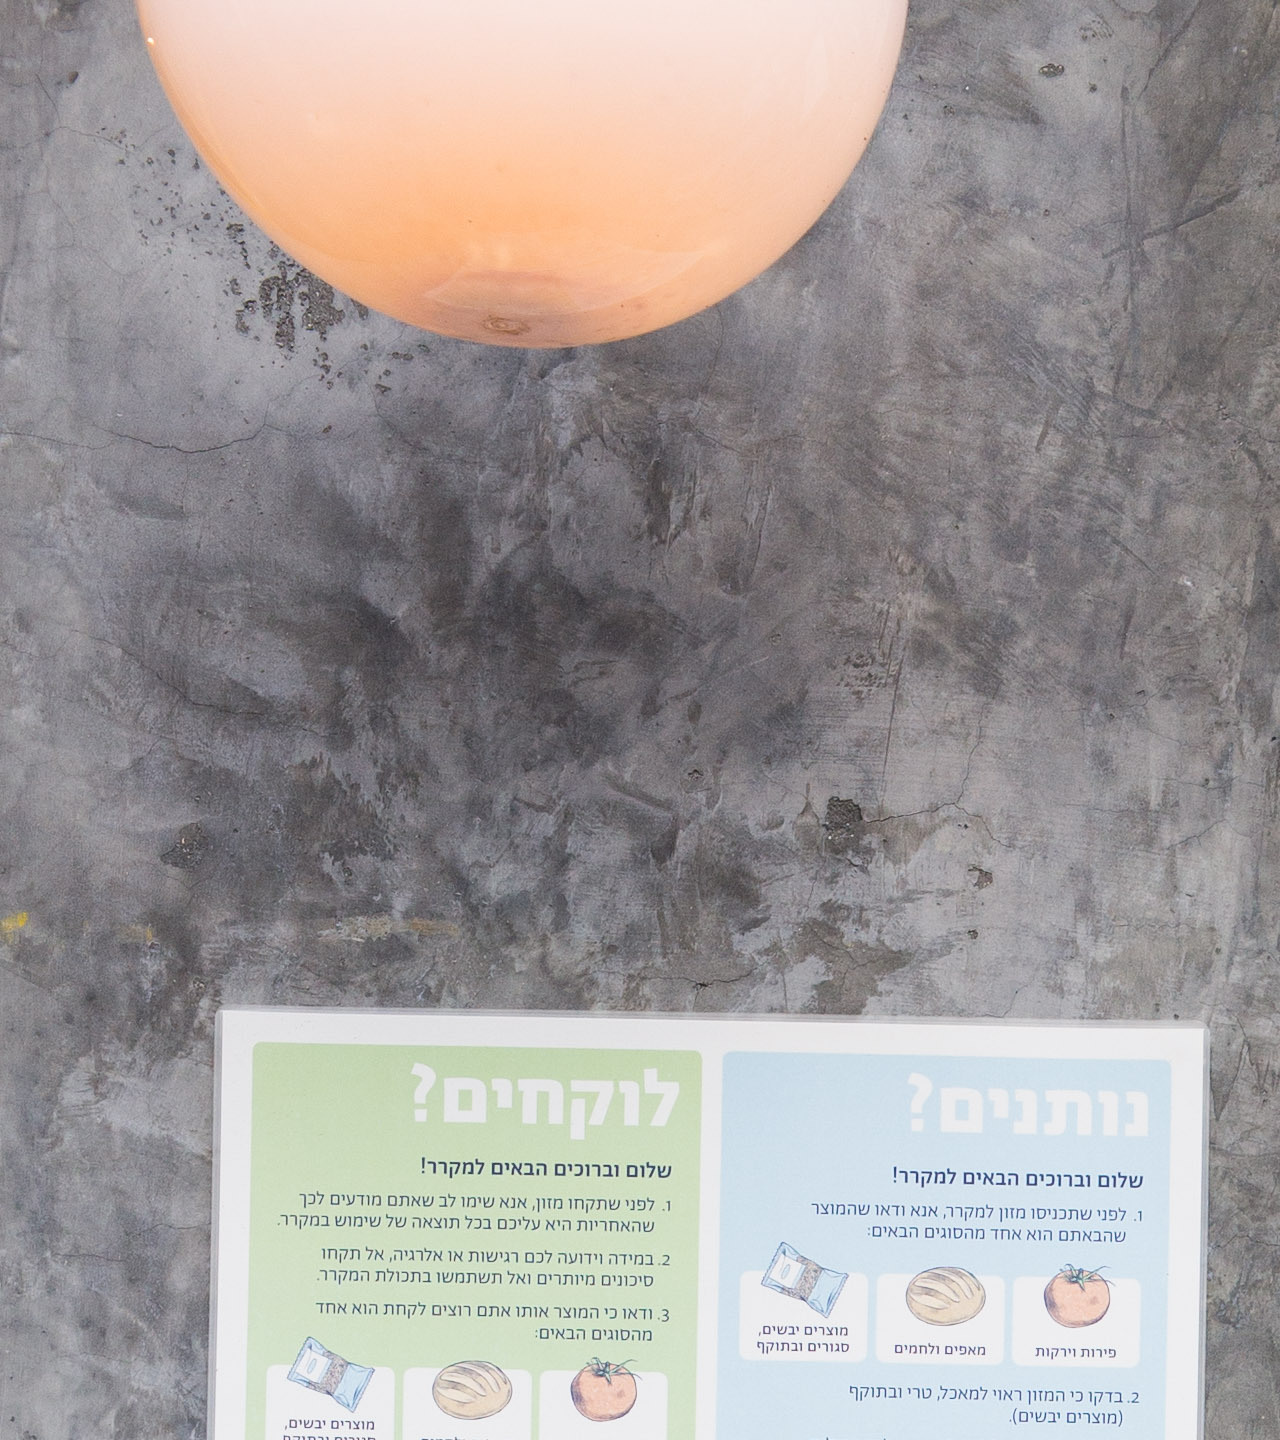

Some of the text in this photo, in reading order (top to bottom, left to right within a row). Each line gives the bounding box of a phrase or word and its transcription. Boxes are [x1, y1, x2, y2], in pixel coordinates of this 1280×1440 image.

[411, 1062, 680, 1140] לוקחים?
[908, 1072, 1149, 1137] נותנים?
[421, 1156, 672, 1179] שלום וברוכים הבאים למקרר!
[893, 1166, 1144, 1189] שלום וברוכים הבאים למקרר!
[758, 1325, 848, 1337] מוצרים יבשים,
[757, 1341, 850, 1355] סגורים ובתוקף
[894, 1342, 986, 1356] מאפים ולחמים
[1035, 1347, 1116, 1360] פירות וירקות
